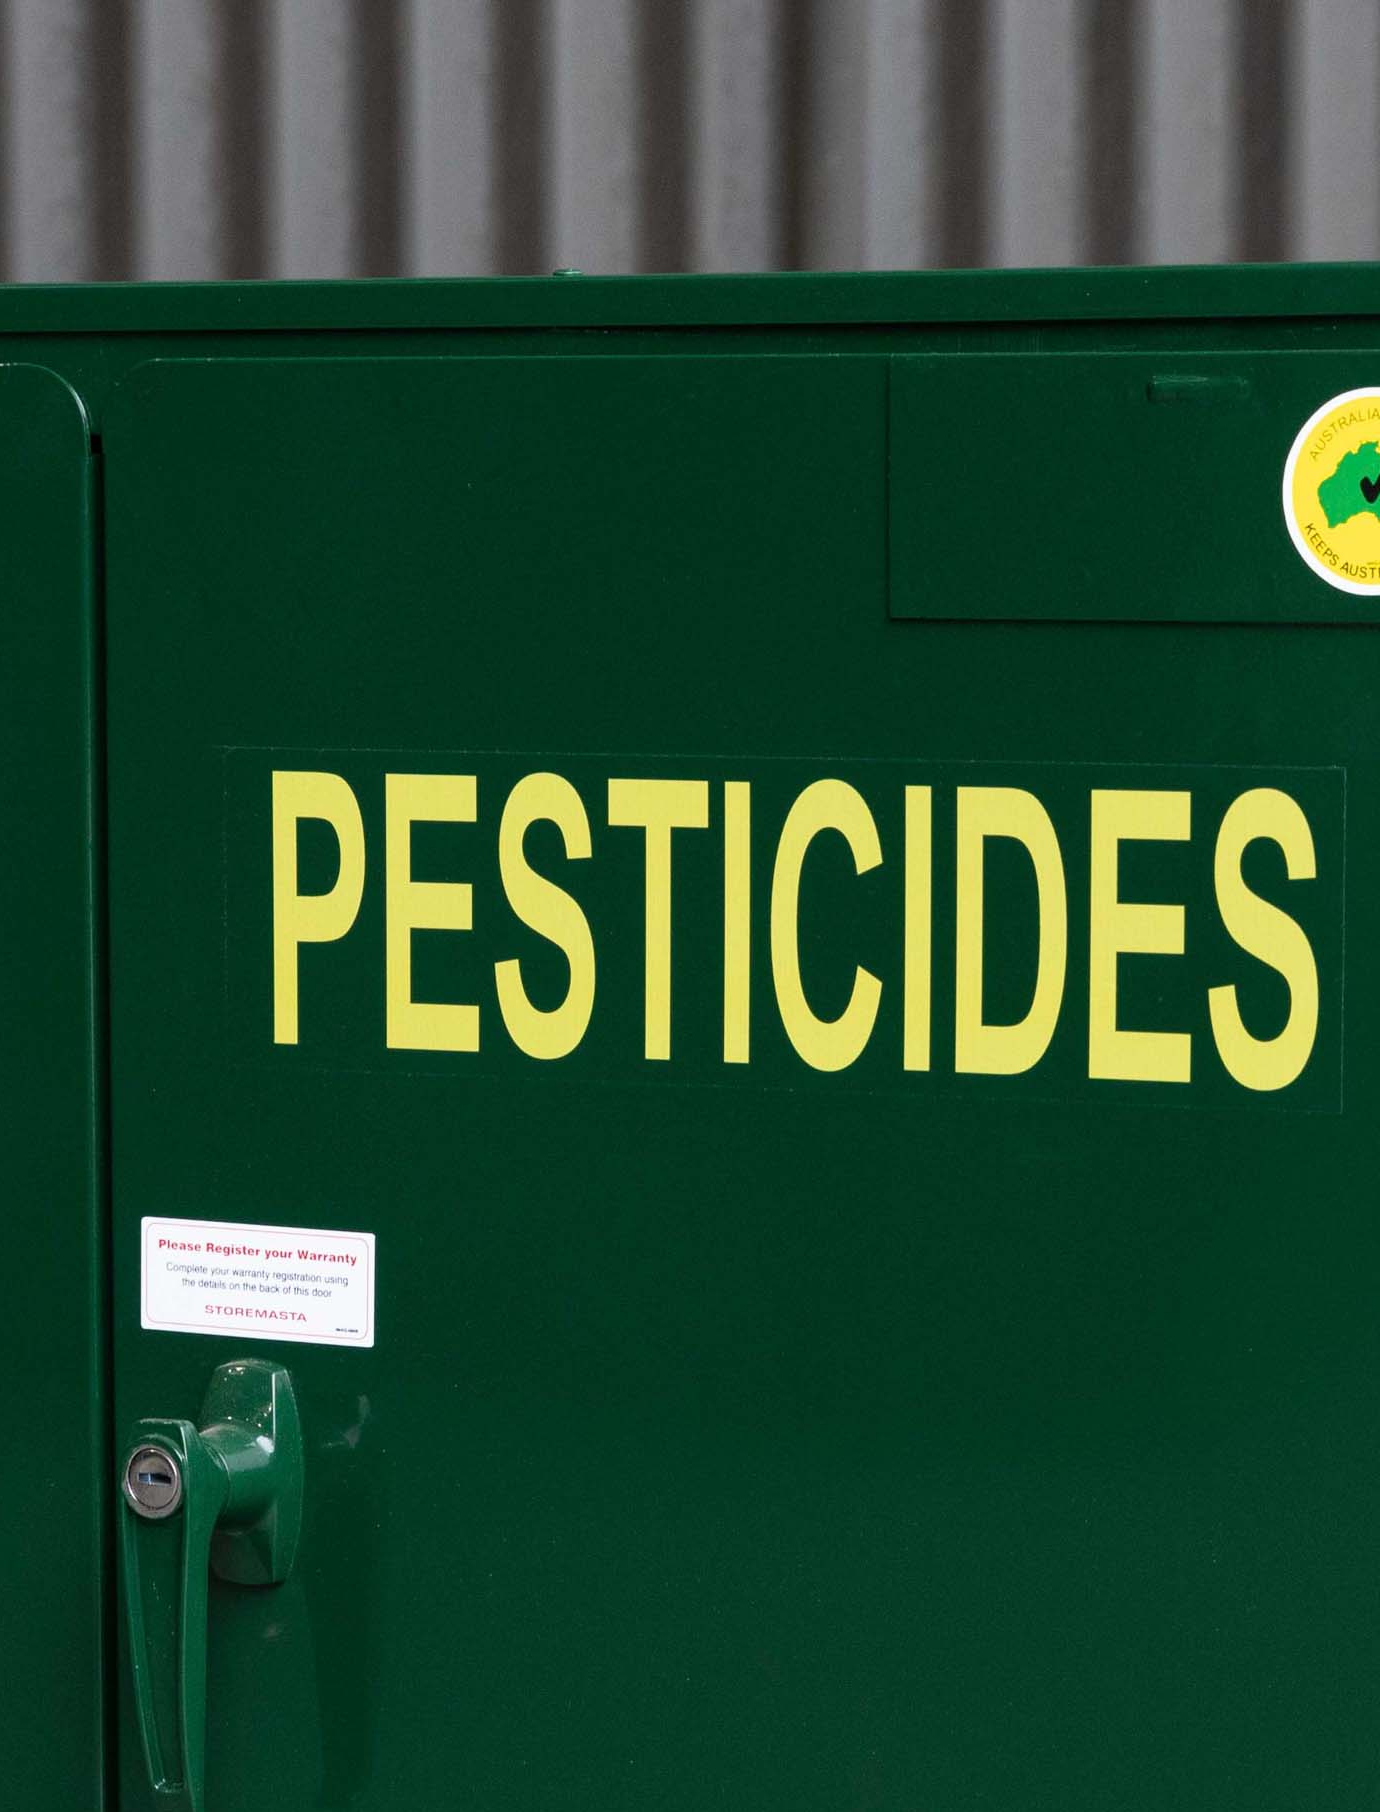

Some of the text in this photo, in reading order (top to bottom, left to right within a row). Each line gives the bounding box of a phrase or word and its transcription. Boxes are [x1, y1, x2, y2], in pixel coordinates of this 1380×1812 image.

[1305, 522, 1340, 566] KEEPS
[272, 769, 1320, 1092] PESTICIDES
[158, 1238, 358, 1266] Please Register your Warranty
[165, 1261, 349, 1287] Complete your warranty registration using
[181, 1277, 333, 1298] the details on the back of this door
[204, 1304, 308, 1322] STOREMASTA
